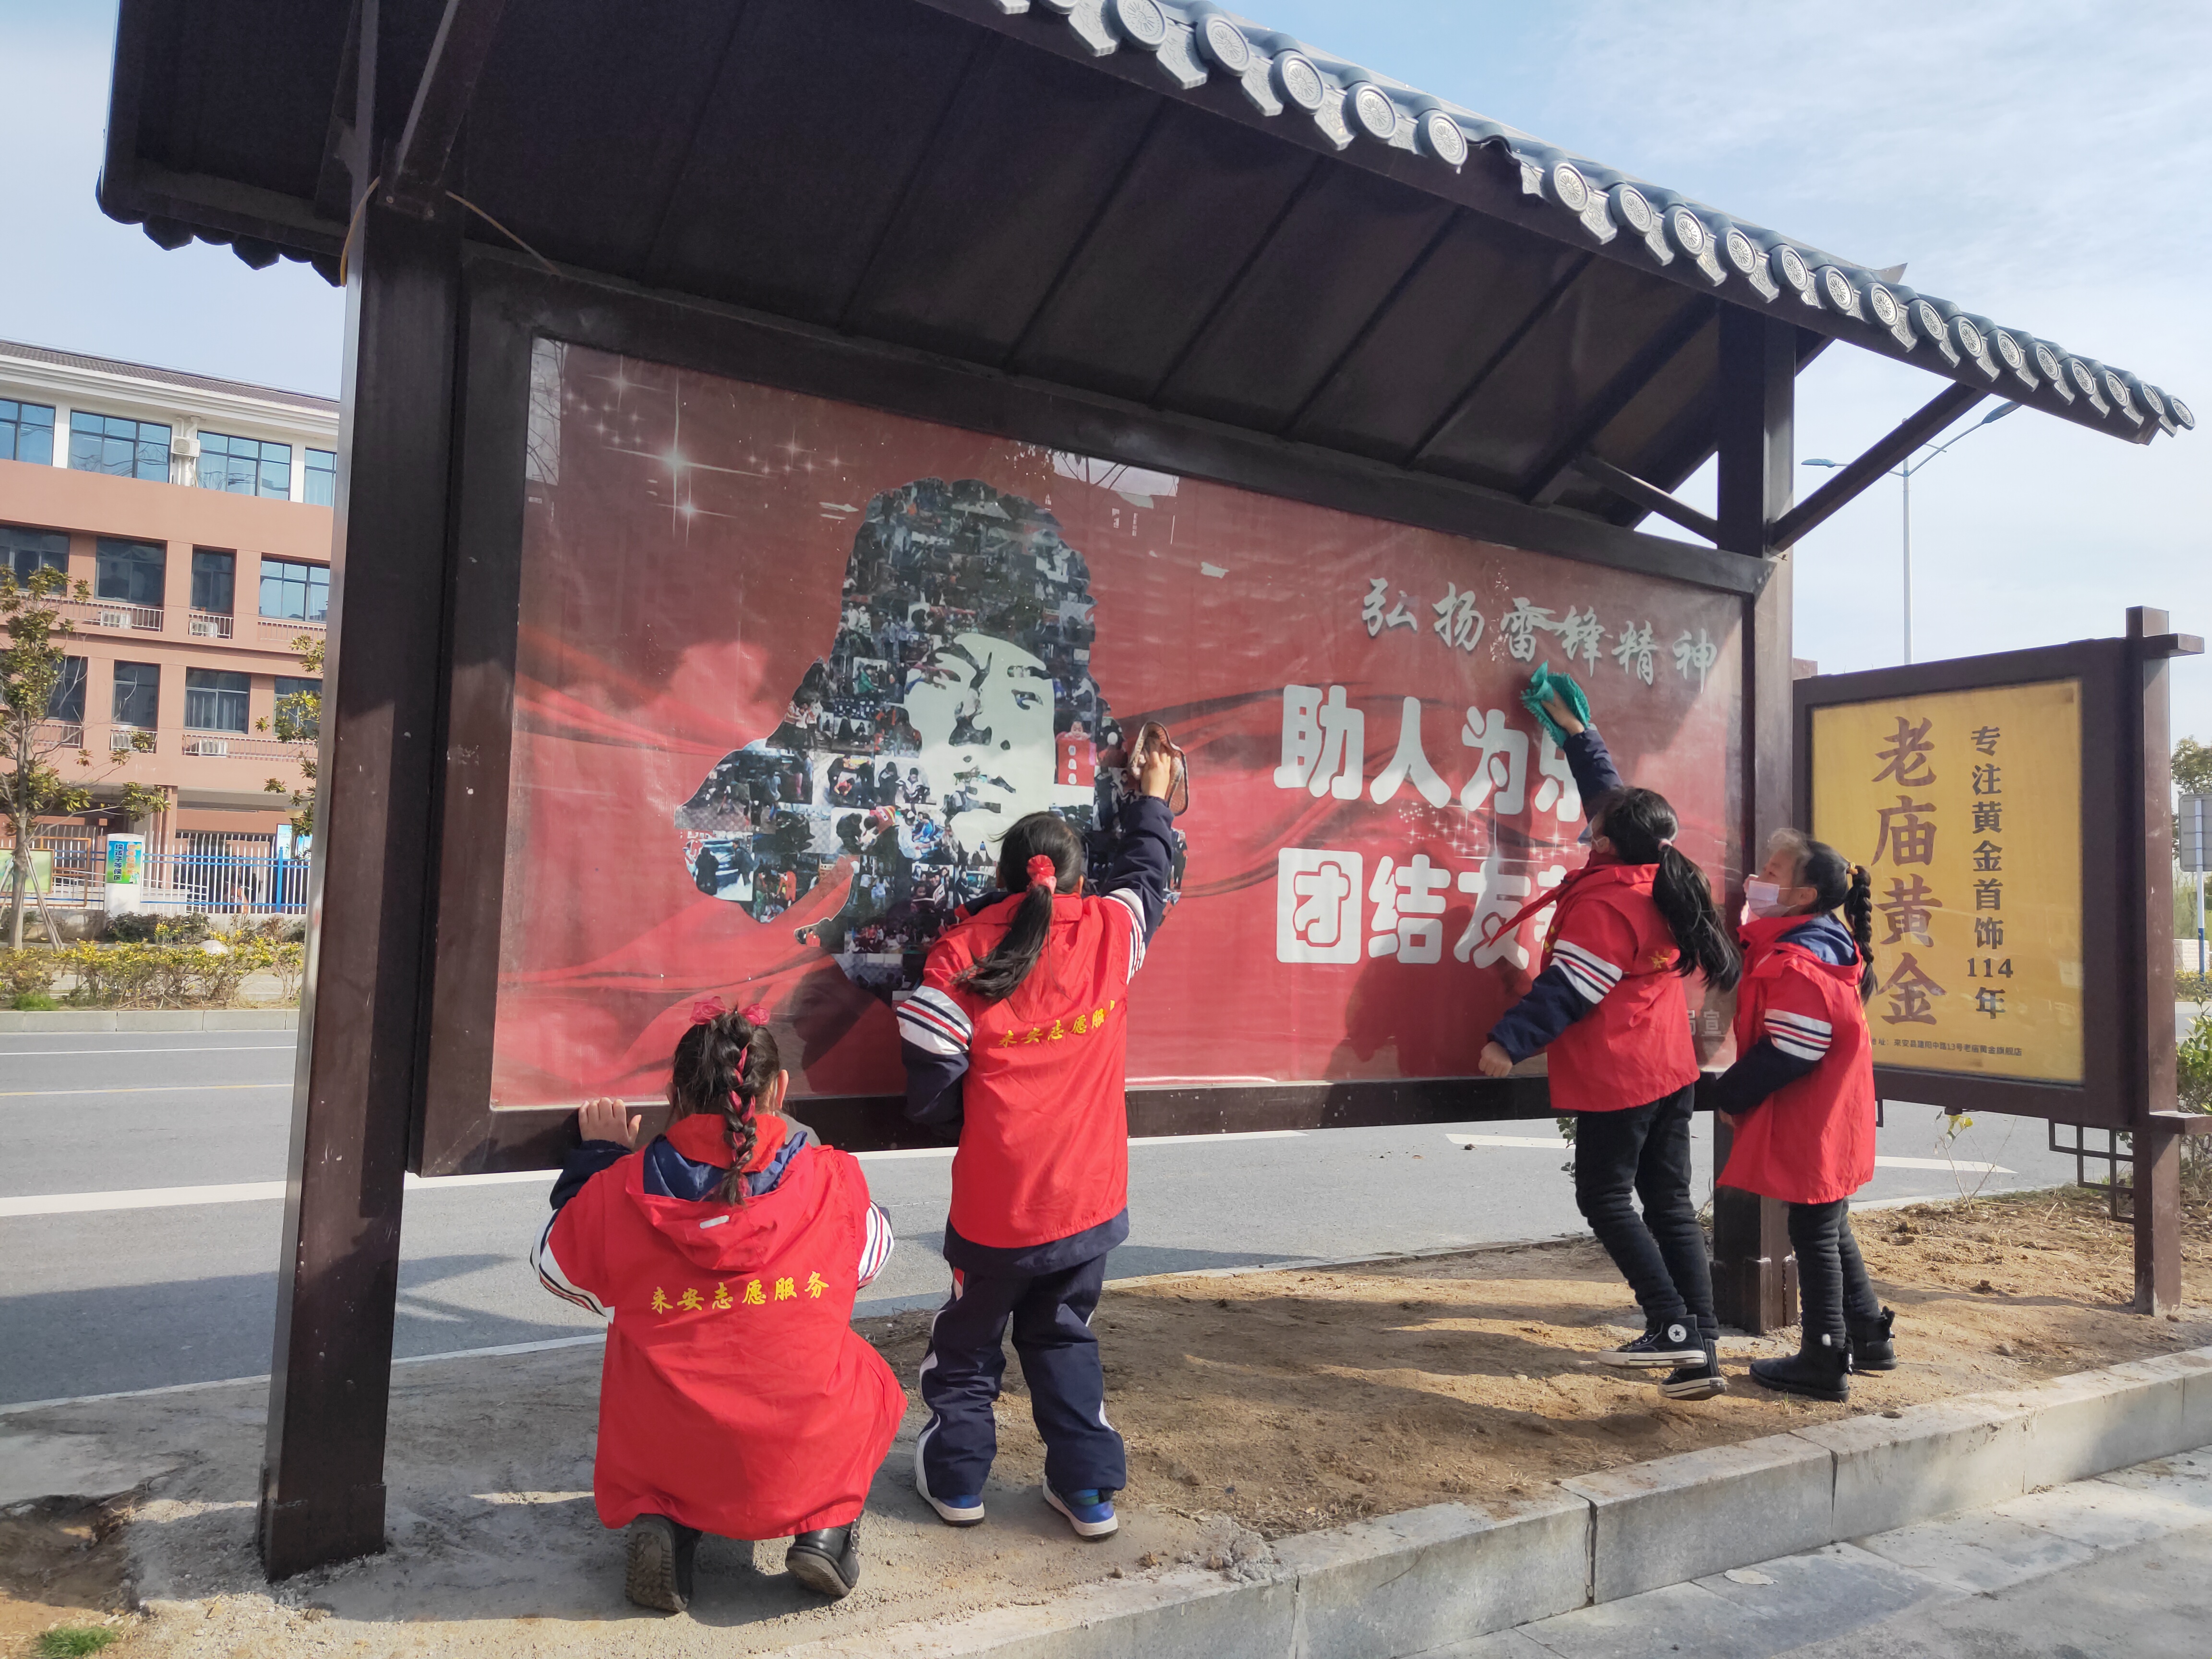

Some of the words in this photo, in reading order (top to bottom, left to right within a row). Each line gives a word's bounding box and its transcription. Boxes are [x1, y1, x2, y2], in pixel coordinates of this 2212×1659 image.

[1362, 577, 1718, 694] 弘扬雷锋精神
[1871, 716, 1947, 1025] 老庙黄金
[998, 999, 1115, 1047] 来安志愿服
[650, 1270, 830, 1315] 来安志愿服务
